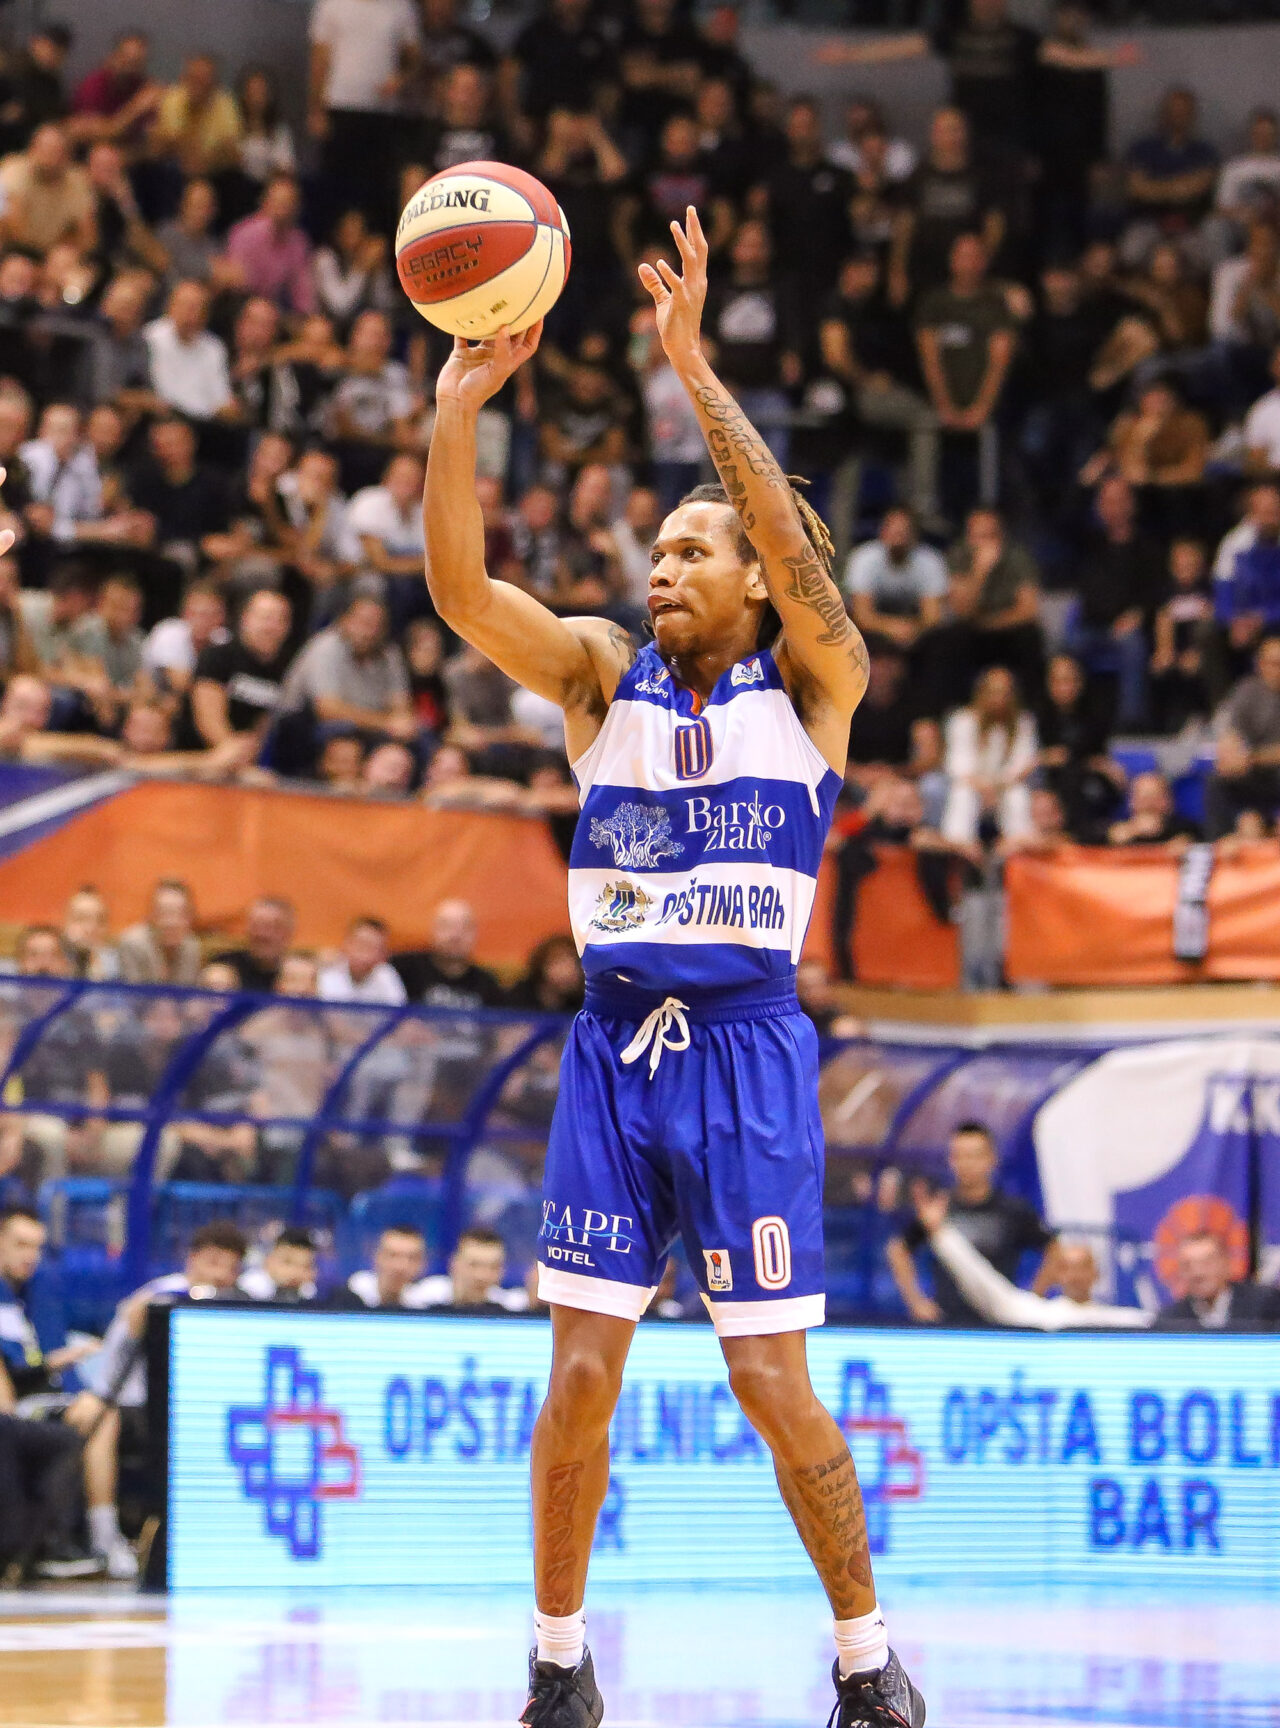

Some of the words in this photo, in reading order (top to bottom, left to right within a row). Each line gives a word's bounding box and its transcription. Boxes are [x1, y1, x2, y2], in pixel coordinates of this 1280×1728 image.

[402, 234, 483, 276] LEGACY
[675, 716, 713, 781] 0
[683, 789, 786, 834] Barsko
[540, 1199, 634, 1254] GAPE
[751, 1215, 792, 1290] 0
[609, 1379, 768, 1465] LNICA
[942, 1367, 1100, 1464] OPŠTA
[1089, 1479, 1222, 1556] BAR
